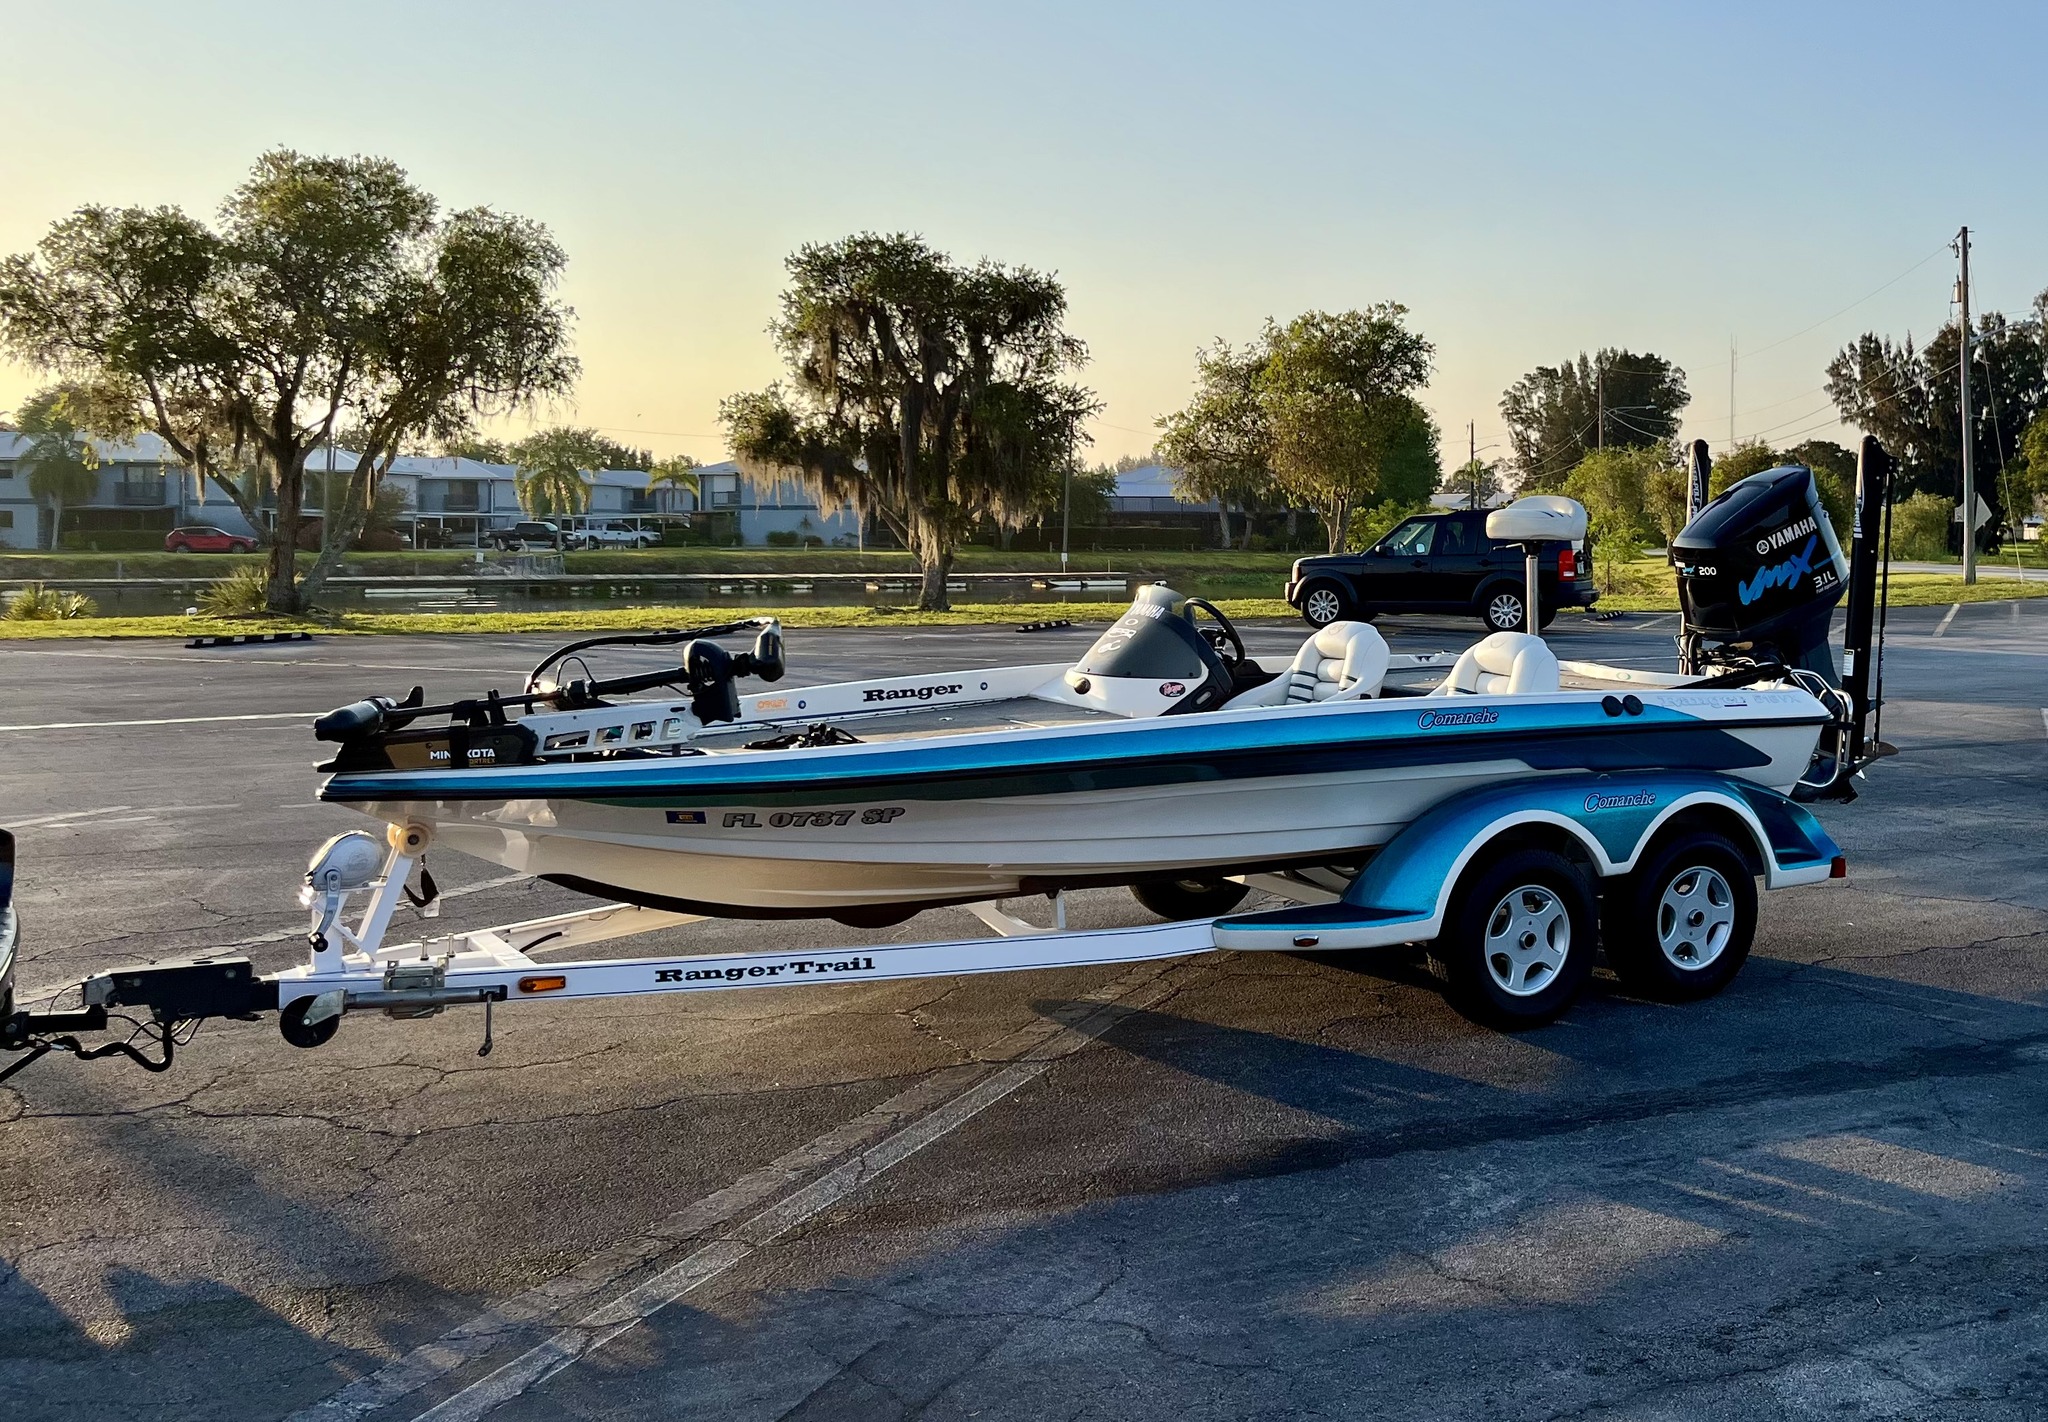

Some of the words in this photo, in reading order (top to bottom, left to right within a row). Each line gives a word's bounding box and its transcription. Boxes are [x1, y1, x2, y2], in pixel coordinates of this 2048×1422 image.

[1767, 516, 1818, 550] YAMAHA
[1698, 566, 1717, 576] 200
[1813, 570, 1836, 588] 3.1L
[863, 684, 963, 702] Ranger
[1418, 707, 1499, 730] Comanche
[430, 750, 452, 760] MIN
[1584, 790, 1657, 813] Comanche
[722, 813, 762, 827] FL
[769, 810, 856, 826] 0737
[861, 807, 906, 825] SP
